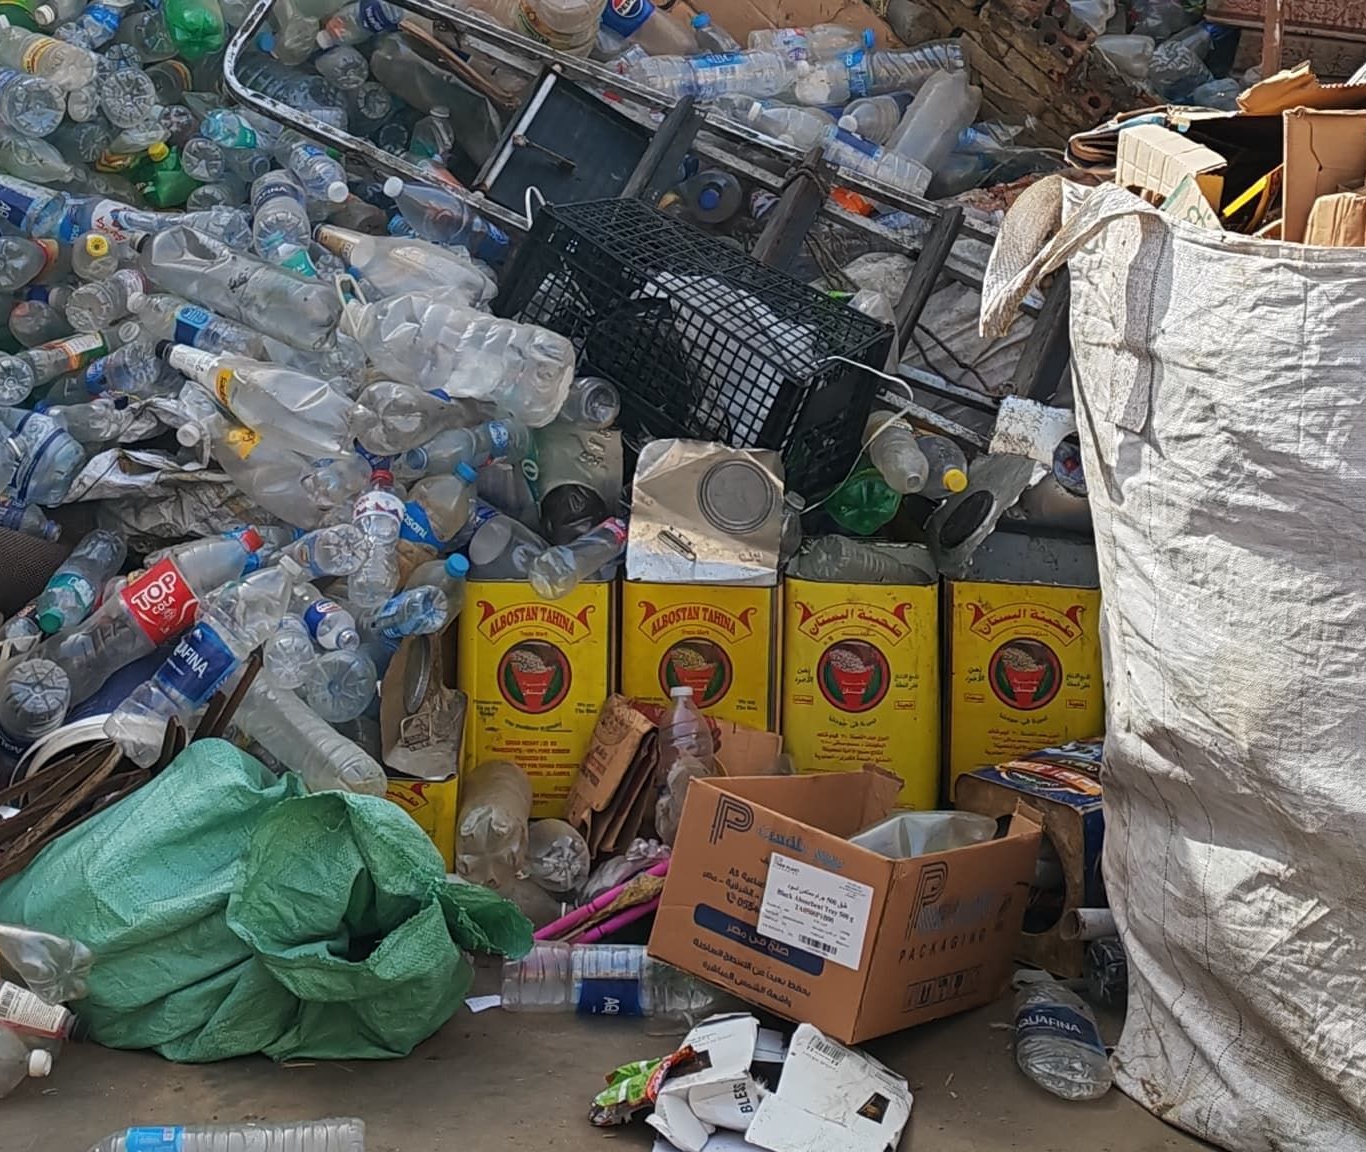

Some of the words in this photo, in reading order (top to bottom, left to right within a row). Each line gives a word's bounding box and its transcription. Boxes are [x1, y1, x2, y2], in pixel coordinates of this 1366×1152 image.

[130, 571, 177, 611] TOP
[153, 591, 177, 617] COLA
[489, 605, 538, 638] ALBOSTAN
[539, 607, 576, 637] TAHINA
[651, 605, 700, 637] ALBOSTAN
[701, 607, 736, 637] TAHINA
[809, 608, 854, 636] البستان
[857, 608, 903, 638] طحينة
[979, 608, 1027, 636] البستان
[1029, 609, 1075, 639] طحينة
[732, 1081, 754, 1116] BLESS
